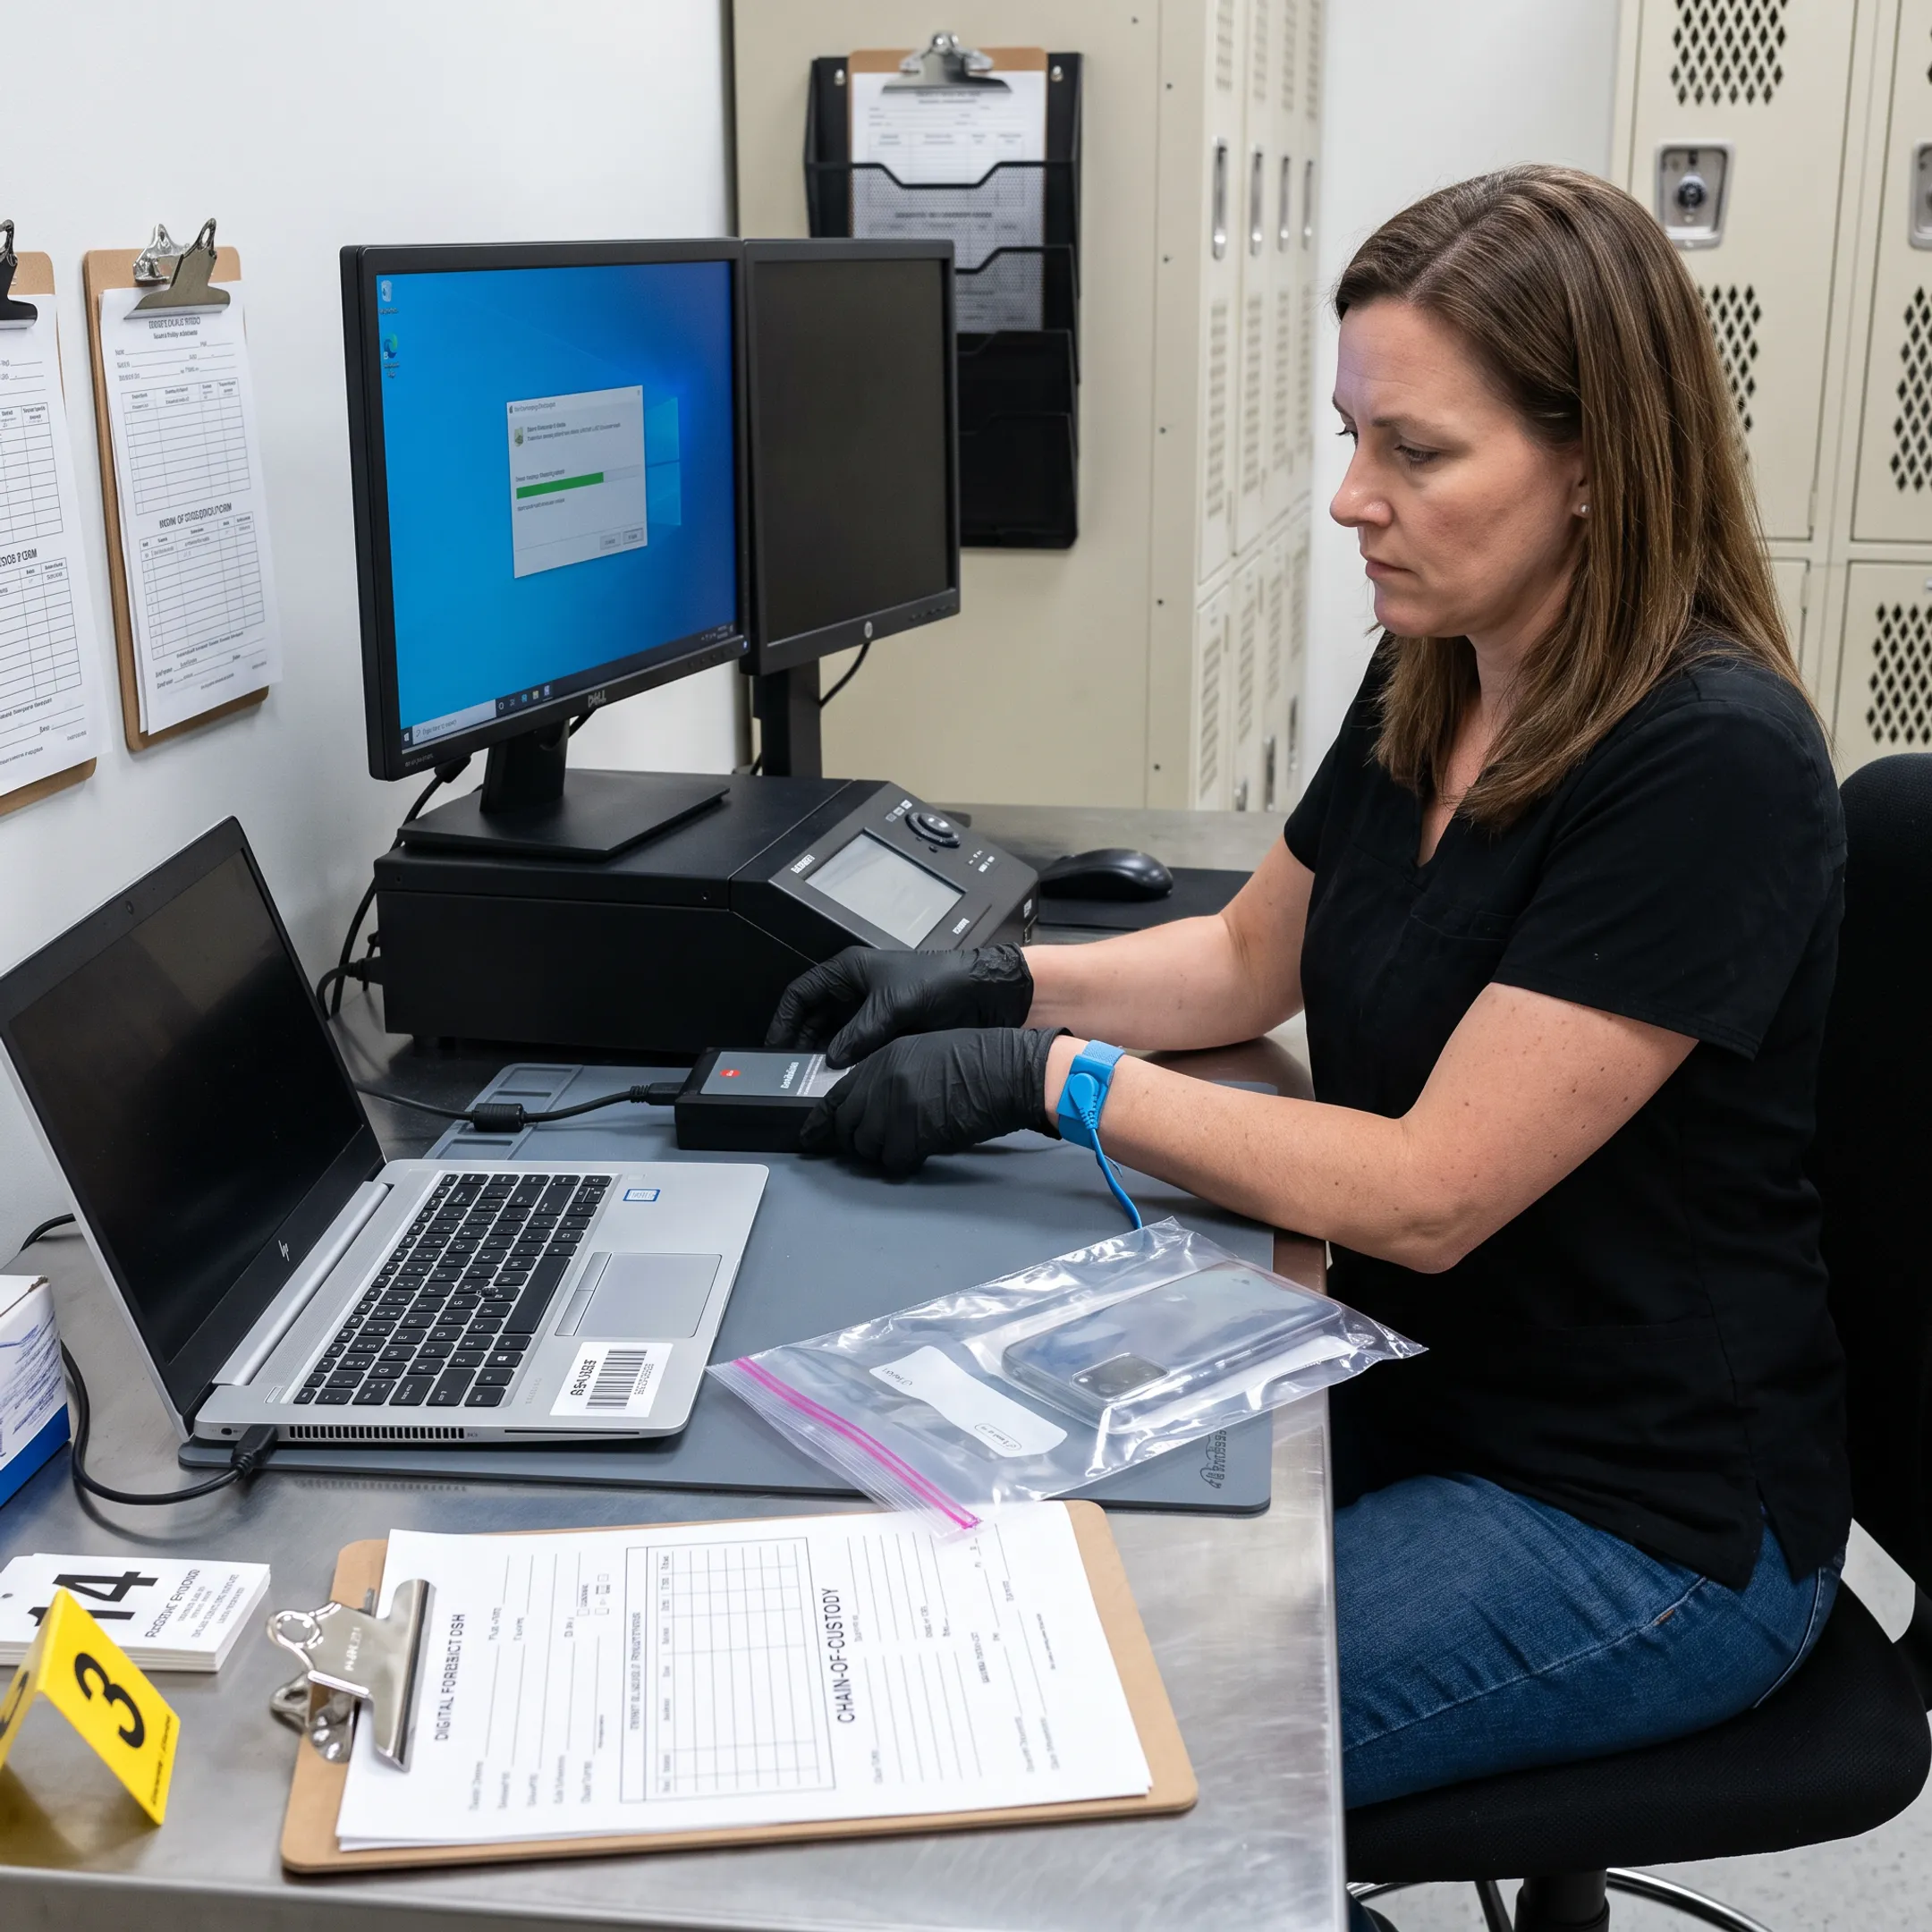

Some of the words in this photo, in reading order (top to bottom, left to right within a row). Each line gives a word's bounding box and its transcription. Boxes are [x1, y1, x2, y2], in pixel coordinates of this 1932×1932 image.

[74, 1652, 147, 1750] 3
[821, 1588, 855, 1724] CHAIN-OF-CUSTODY
[435, 1697, 454, 1741] DIGITAL
